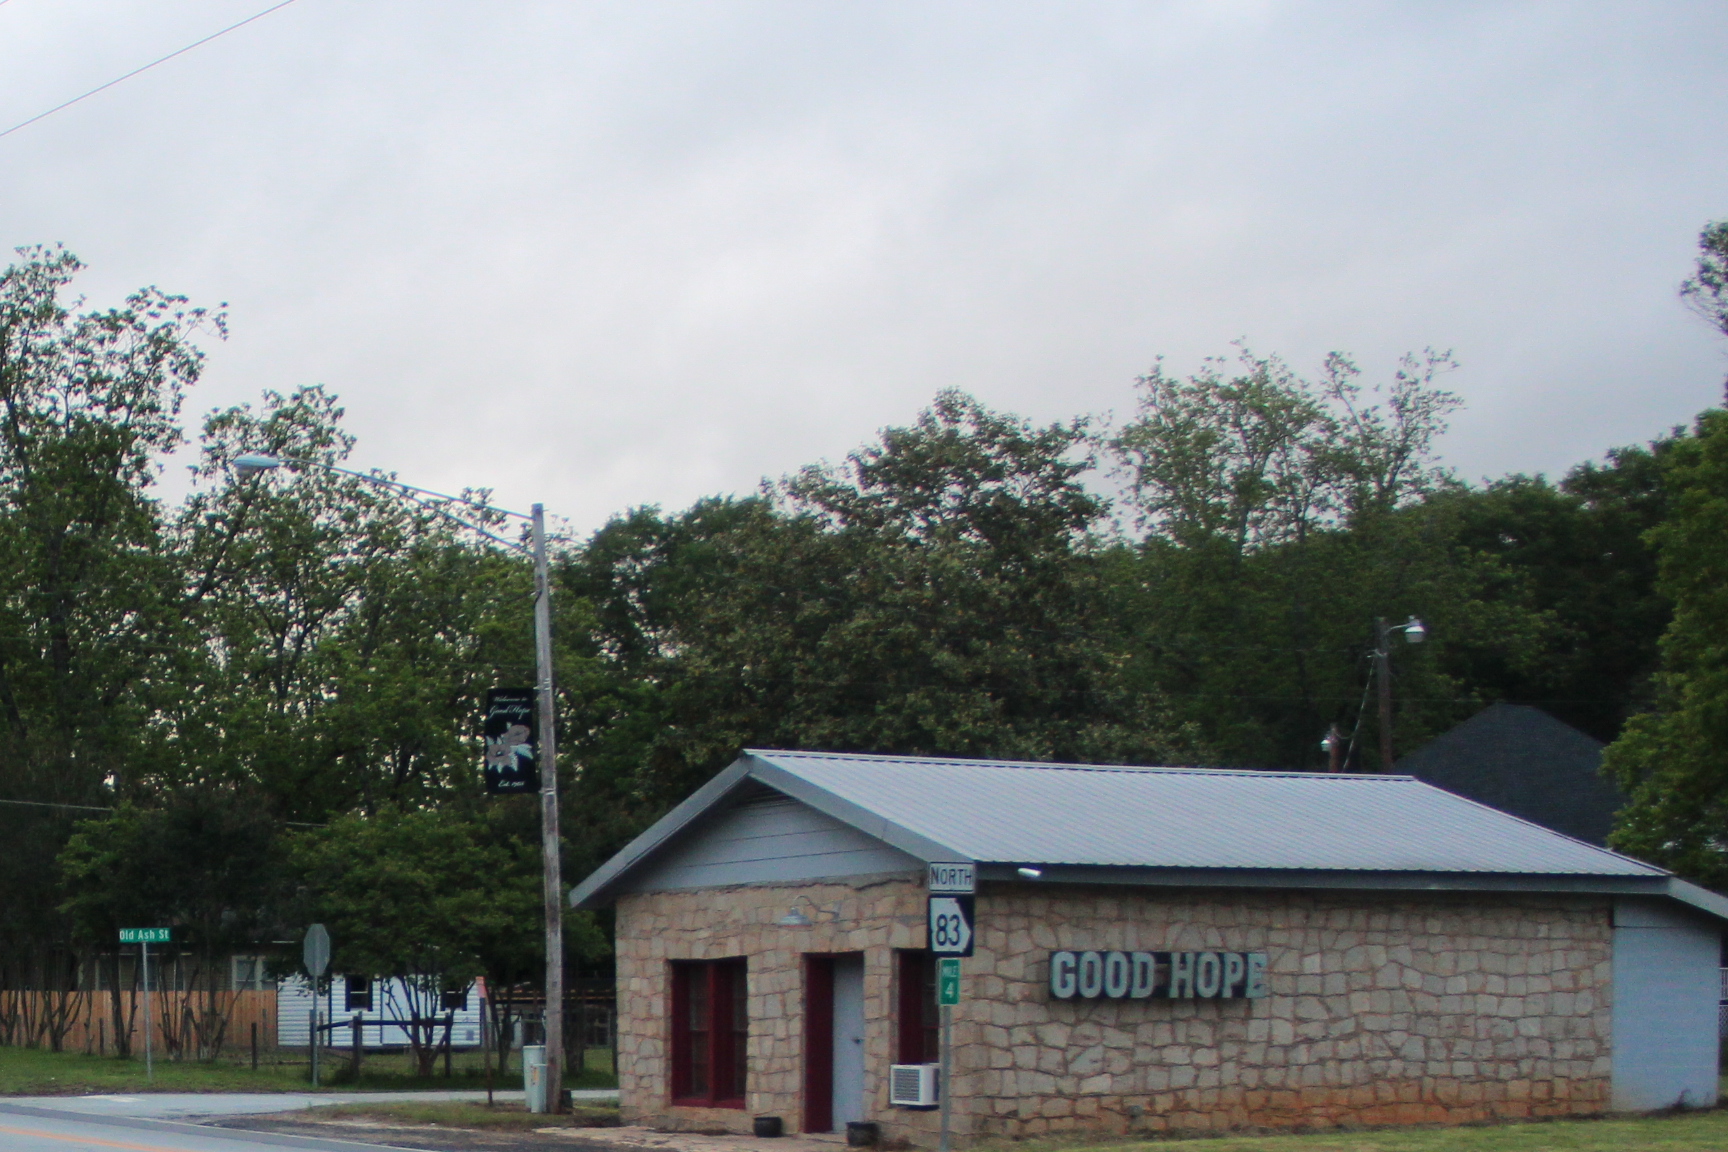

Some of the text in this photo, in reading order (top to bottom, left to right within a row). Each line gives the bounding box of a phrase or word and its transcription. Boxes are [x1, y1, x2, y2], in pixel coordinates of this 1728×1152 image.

[931, 867, 972, 886] NORTH
[120, 929, 169, 940] Old Ash St
[936, 914, 960, 946] 83
[941, 965, 959, 978] MILE
[1051, 951, 1268, 998] GOOD HOPE
[945, 981, 955, 998] 4
